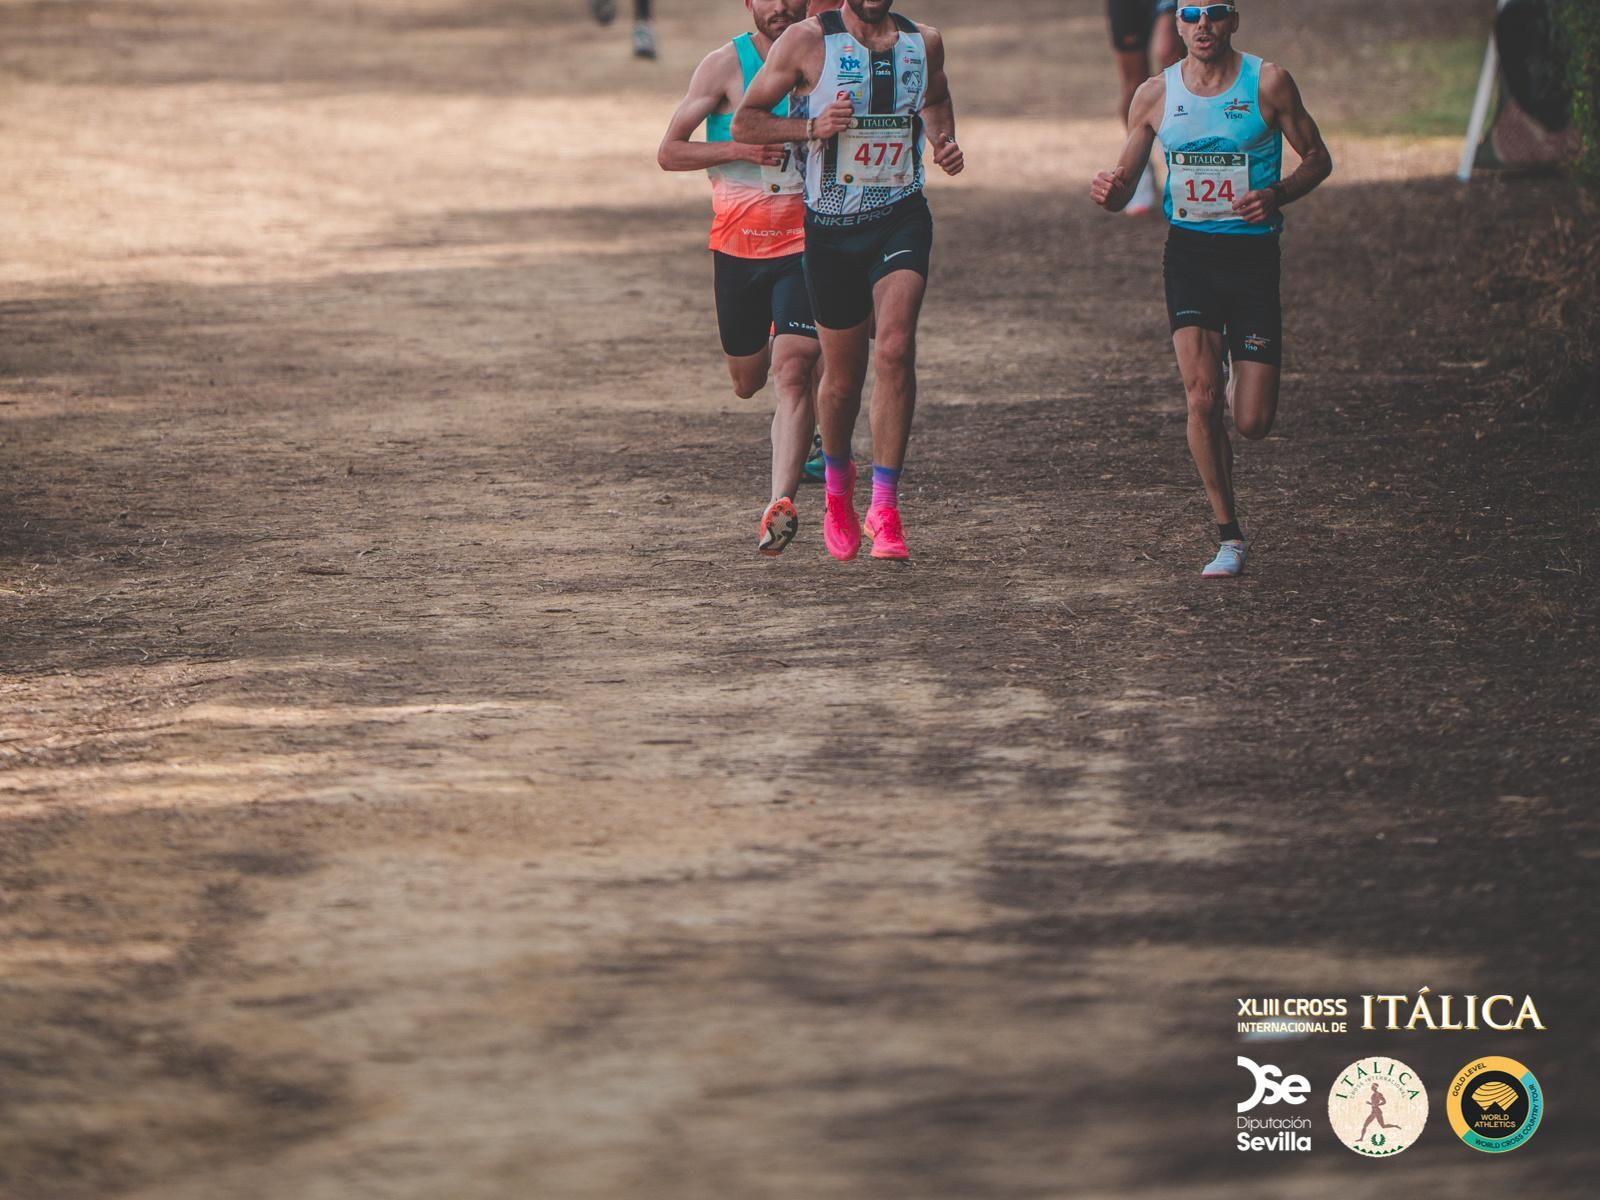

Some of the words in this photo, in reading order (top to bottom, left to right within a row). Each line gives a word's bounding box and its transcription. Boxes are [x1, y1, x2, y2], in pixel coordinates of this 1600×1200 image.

[854, 142, 904, 167] 477
[1184, 179, 1235, 203] 124
[813, 214, 855, 227] NIKE
[857, 206, 893, 224] PRO
[741, 228, 783, 237] VALORA
